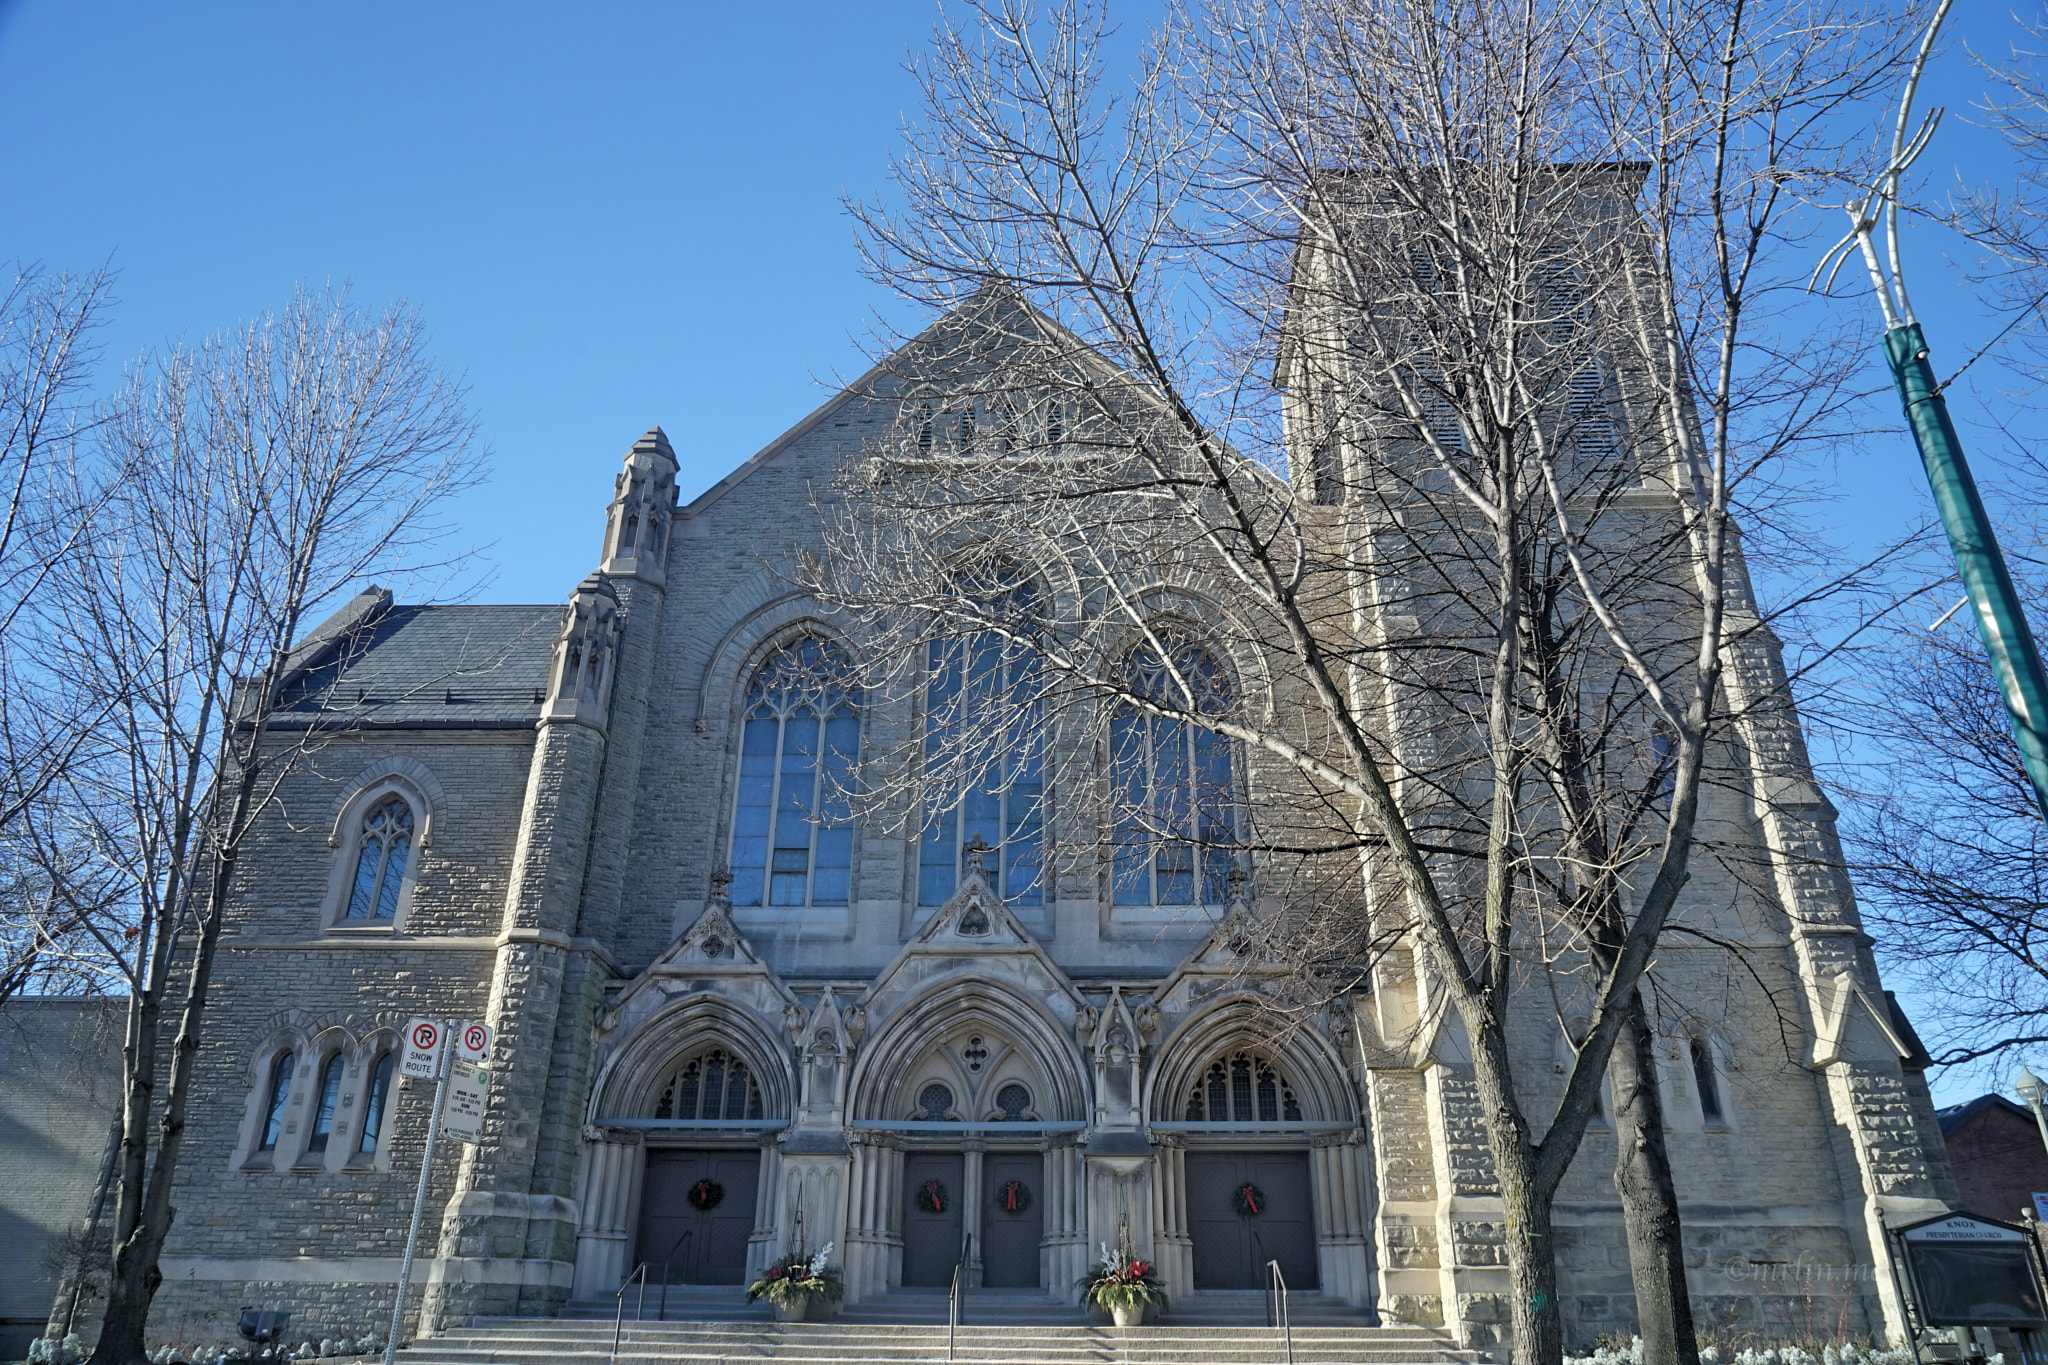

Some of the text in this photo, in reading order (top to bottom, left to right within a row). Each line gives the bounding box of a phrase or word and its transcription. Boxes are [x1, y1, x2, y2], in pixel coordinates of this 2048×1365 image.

[410, 1051, 432, 1062] SNOW
[405, 1061, 432, 1073] ROUTE
[1946, 1220, 1976, 1229] KNOX
[1925, 1231, 1975, 1239] PRESBYTERIAN
